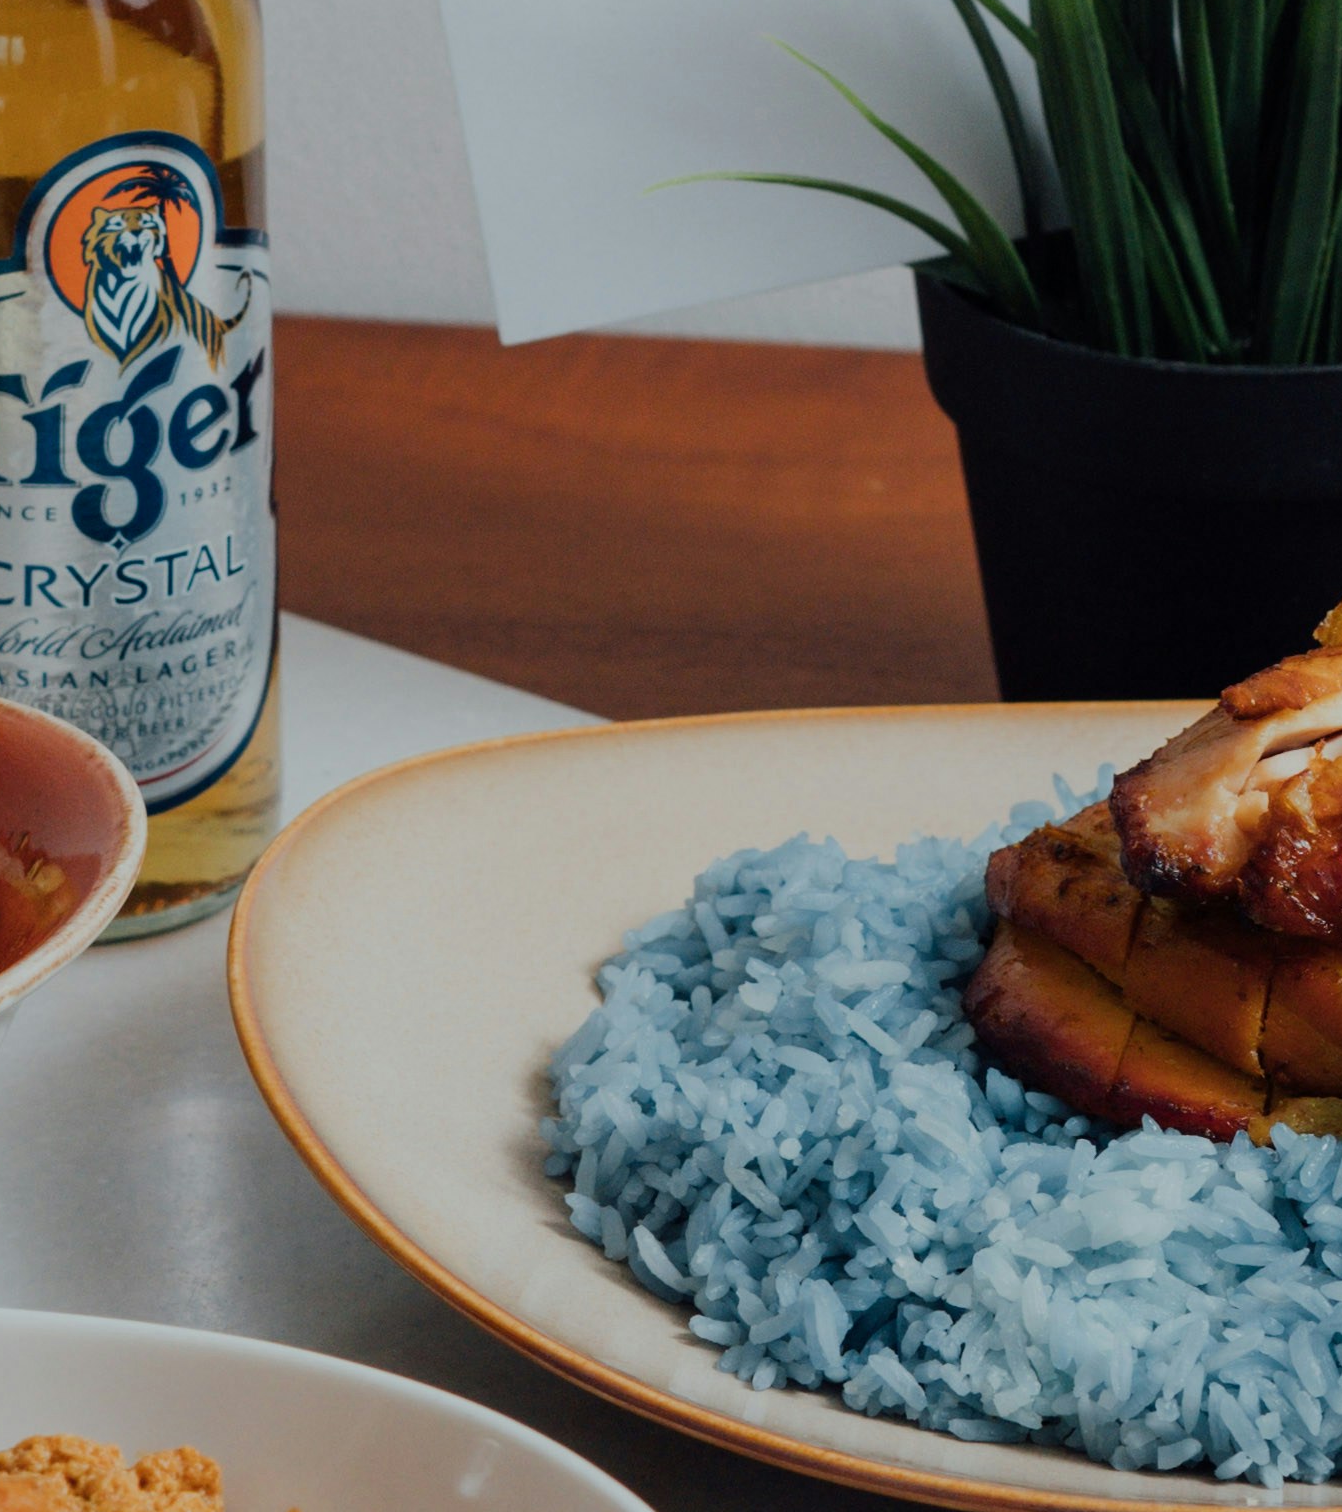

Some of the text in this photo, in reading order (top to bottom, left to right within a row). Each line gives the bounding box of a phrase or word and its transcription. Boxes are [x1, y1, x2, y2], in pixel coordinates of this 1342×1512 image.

[179, 476, 233, 508] 1932
[80, 579, 257, 661] Acclaimed
[135, 640, 236, 685] LAGER
[137, 716, 186, 737] BEER
[127, 734, 207, 773] NGAPORE
